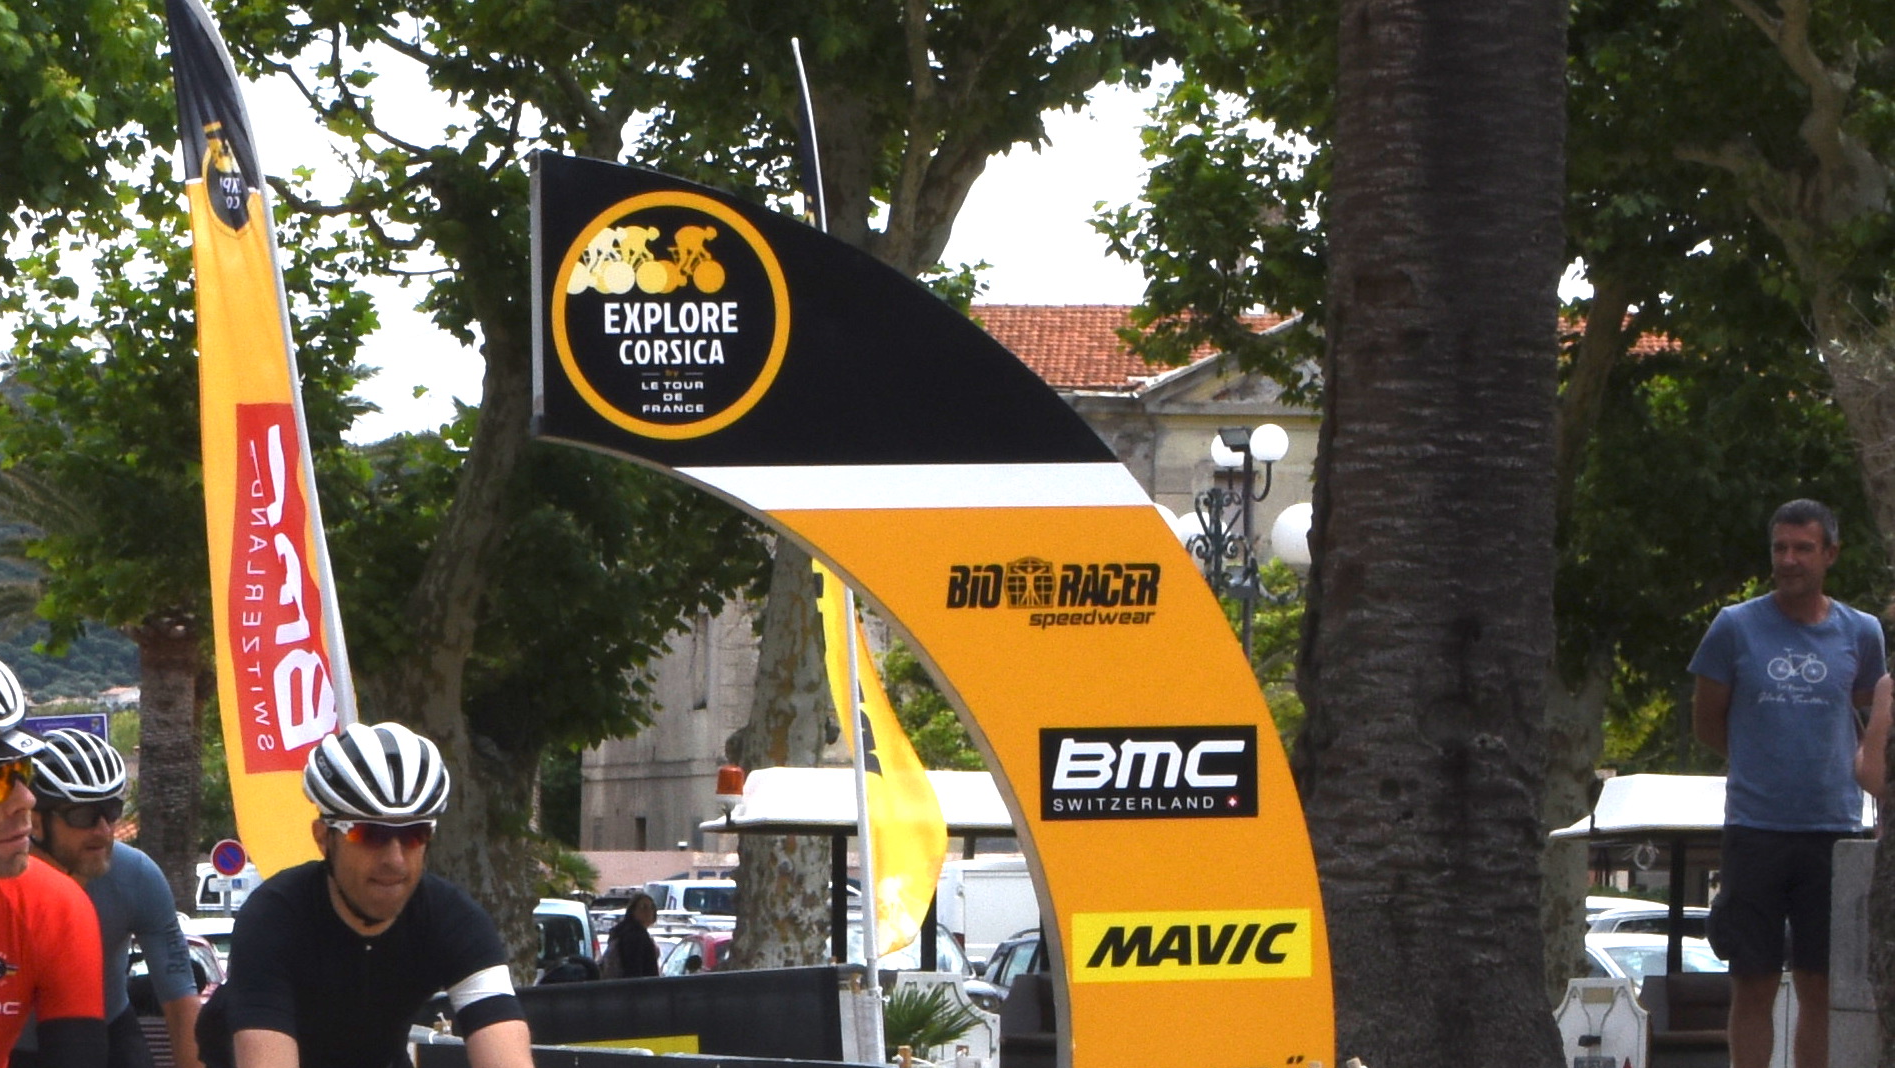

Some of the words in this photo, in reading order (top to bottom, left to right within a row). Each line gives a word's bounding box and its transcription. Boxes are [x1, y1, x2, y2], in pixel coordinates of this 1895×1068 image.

[603, 302, 739, 335] EXPLORE
[619, 339, 725, 366] CORSICA
[641, 381, 659, 391] LE
[663, 381, 704, 391] TOUR
[663, 392, 683, 402] DE
[642, 404, 704, 414] FRANCE
[1028, 609, 1155, 631] speedwear
[1052, 738, 1245, 791] BMC
[1052, 795, 1216, 813] SWITZERLAND
[1086, 922, 1298, 969] MAVIC
